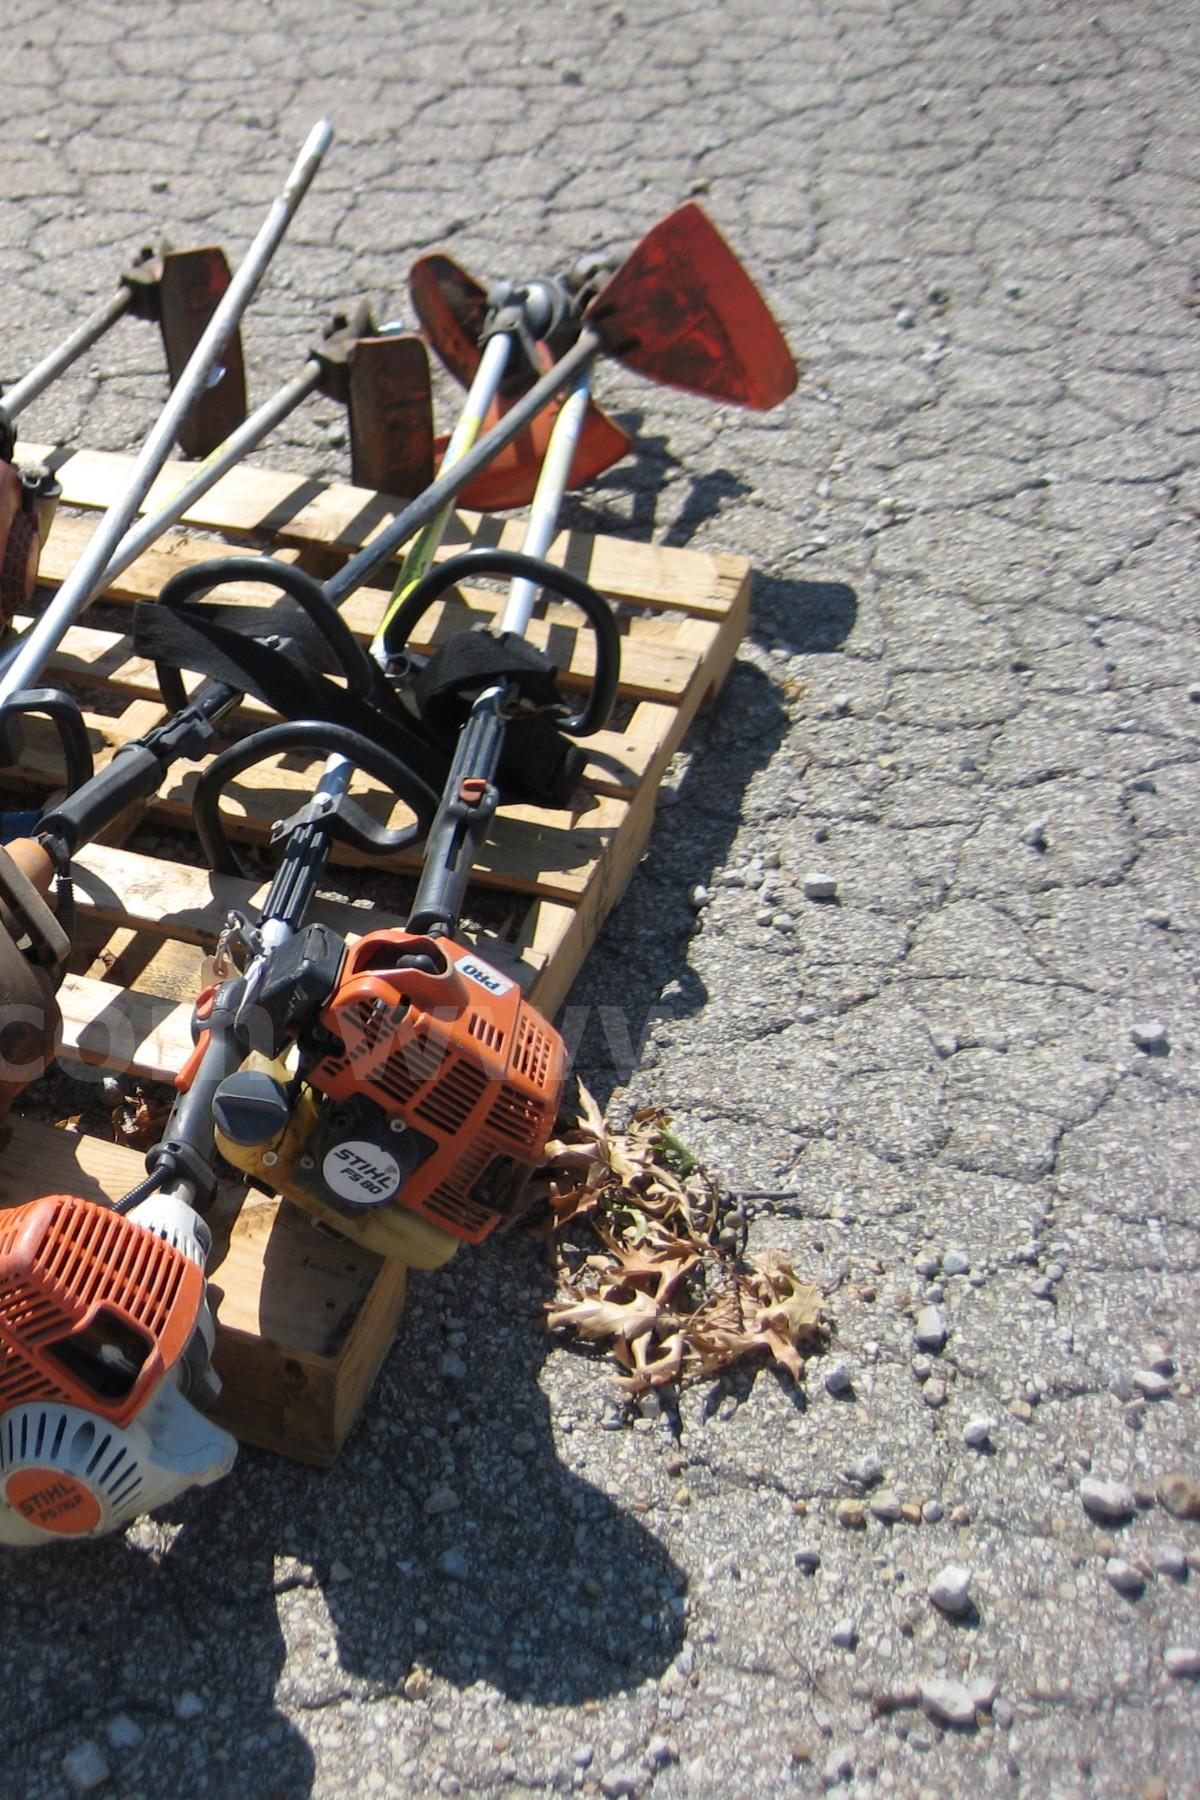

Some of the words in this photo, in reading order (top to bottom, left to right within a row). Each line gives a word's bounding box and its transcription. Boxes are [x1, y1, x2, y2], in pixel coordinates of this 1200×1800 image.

[462, 964, 501, 990] PRO
[333, 1148, 392, 1189] STIHL
[340, 1167, 364, 1183] FS
[360, 1180, 384, 1195] 80
[19, 1481, 78, 1517] STIHL
